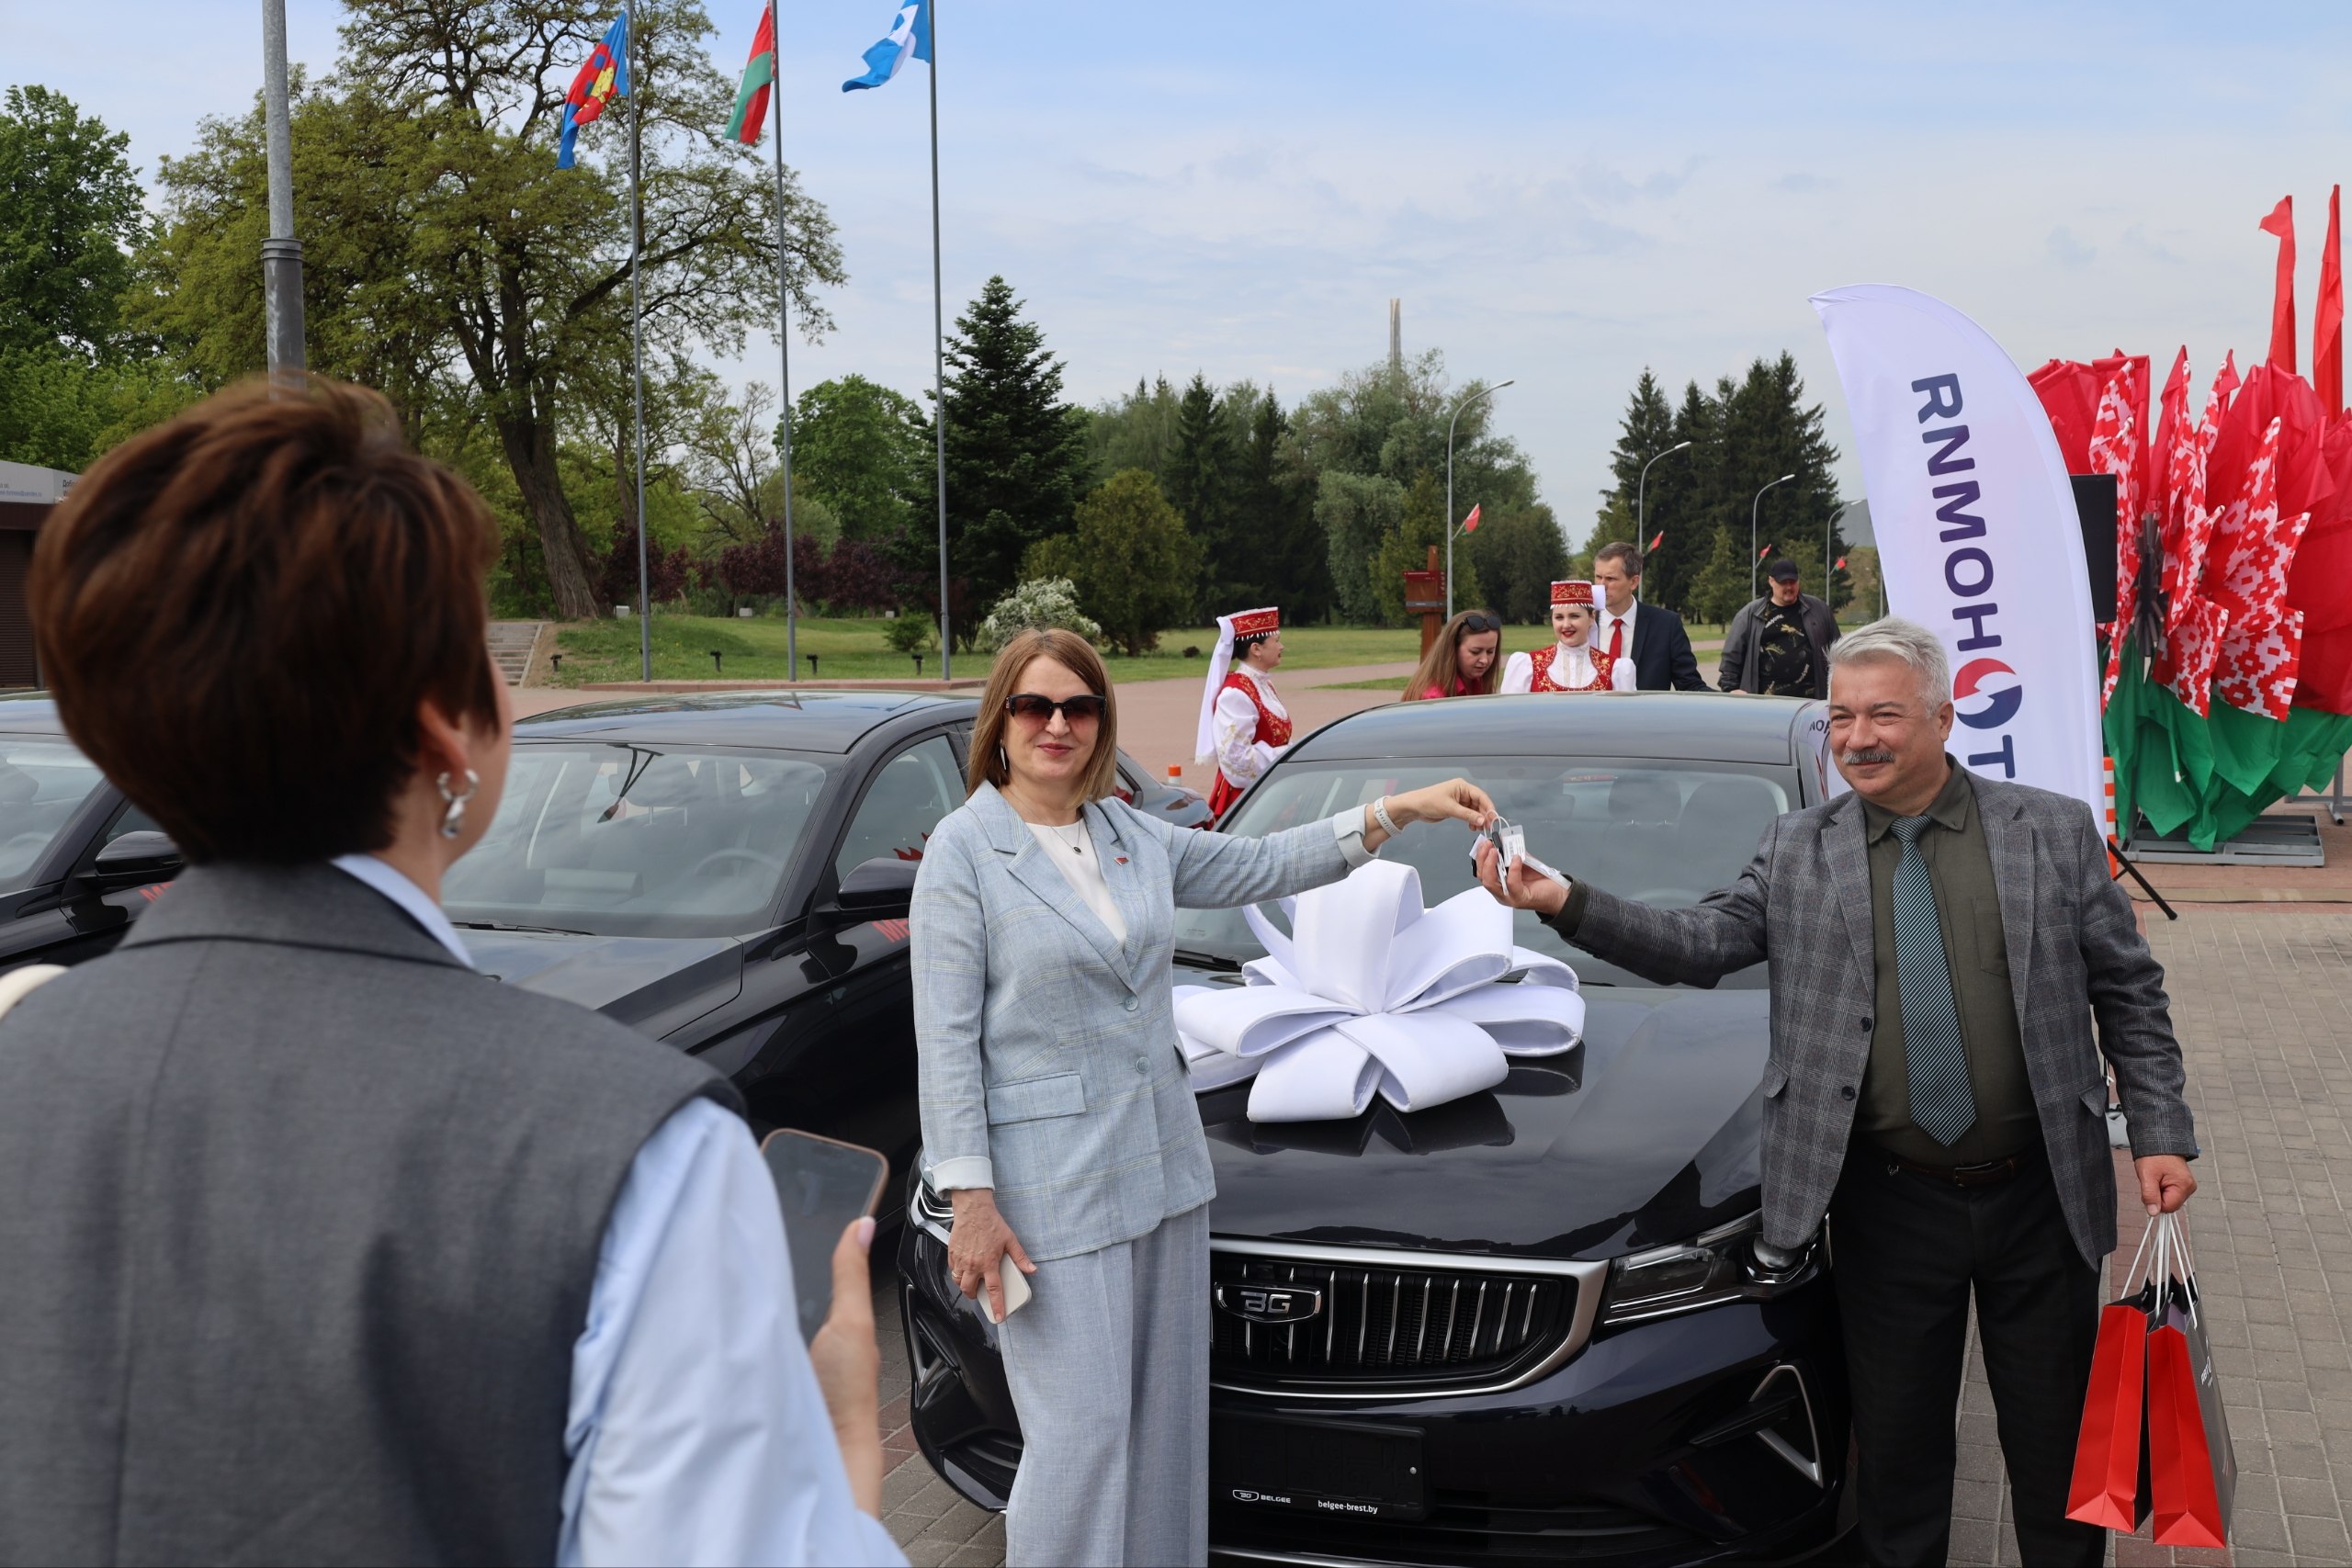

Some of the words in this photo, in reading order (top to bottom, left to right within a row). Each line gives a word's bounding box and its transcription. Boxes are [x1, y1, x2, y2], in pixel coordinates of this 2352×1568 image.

[1240, 1291, 1292, 1314] BG
[1261, 1495, 1291, 1504] BELGEE
[1317, 1500, 1378, 1515] belgee-brest.by
